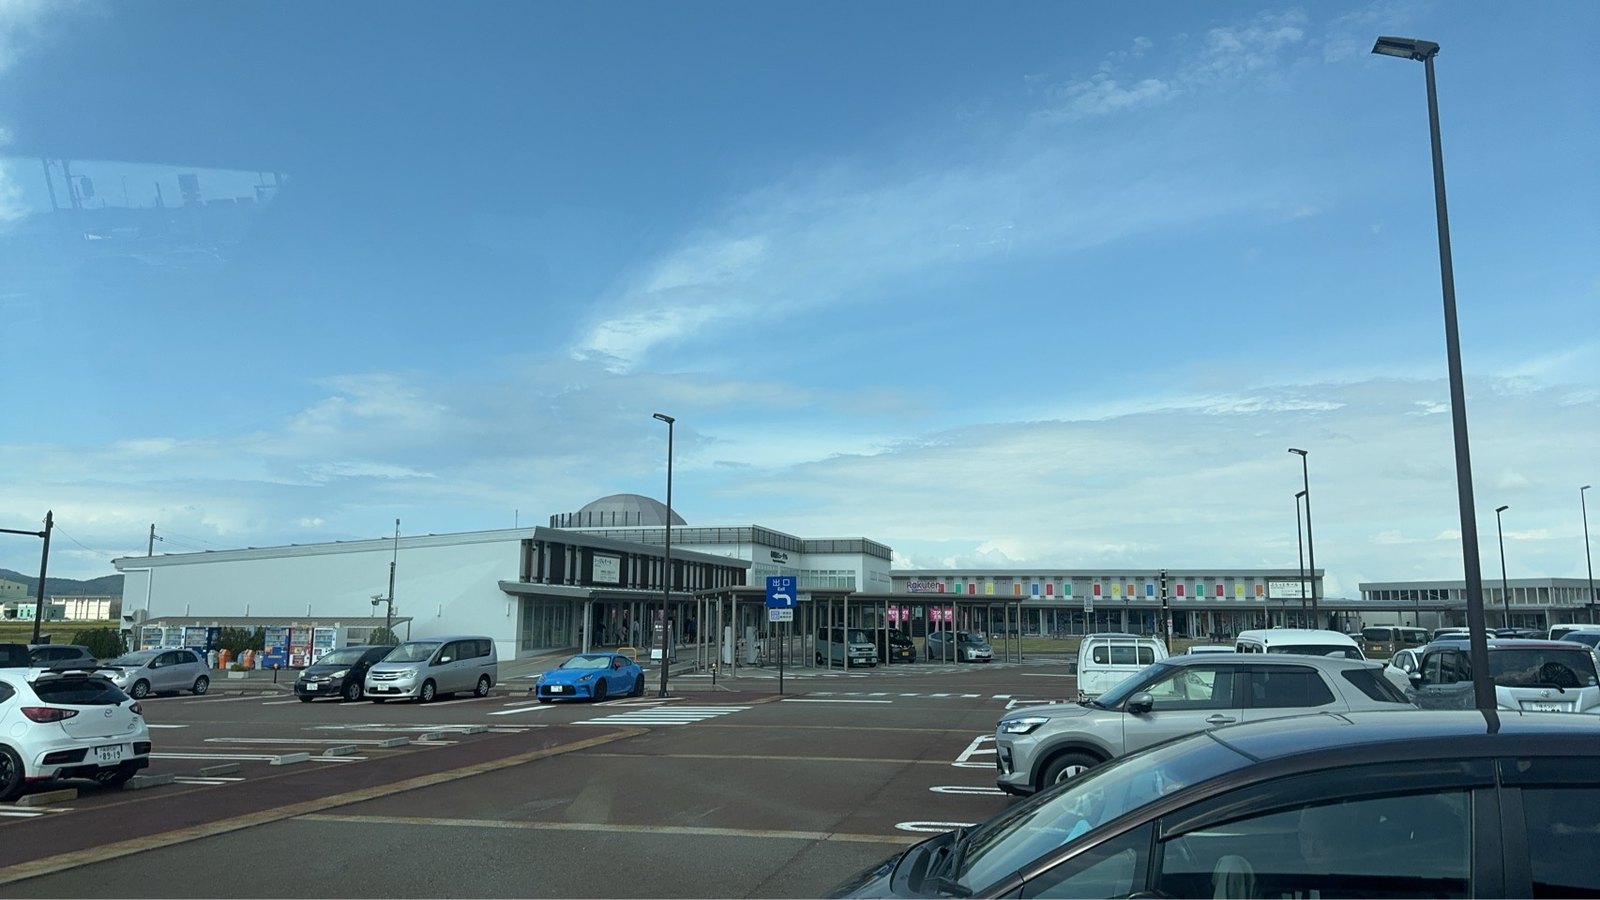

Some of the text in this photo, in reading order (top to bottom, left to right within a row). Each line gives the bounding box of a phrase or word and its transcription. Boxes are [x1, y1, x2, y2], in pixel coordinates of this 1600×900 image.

[772, 578, 790, 587] 出口
[906, 580, 941, 589] Rakuten
[102, 751, 121, 760] 89-19
